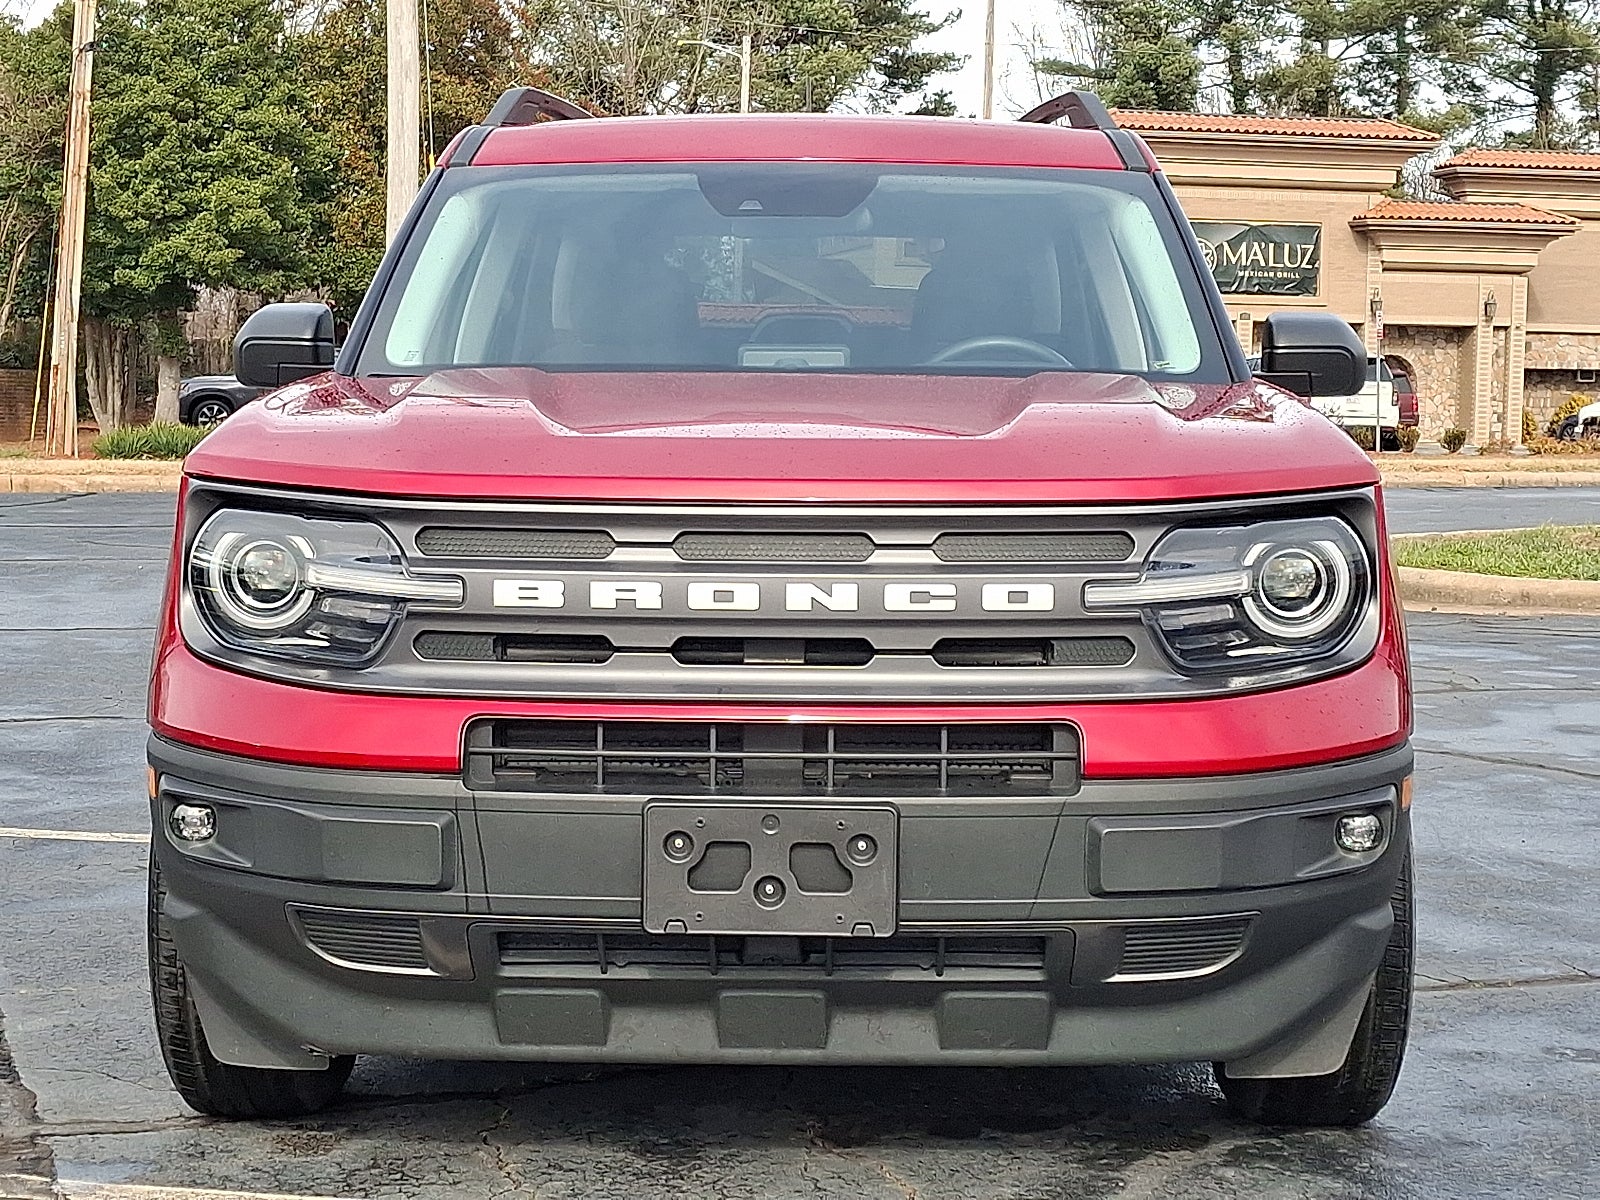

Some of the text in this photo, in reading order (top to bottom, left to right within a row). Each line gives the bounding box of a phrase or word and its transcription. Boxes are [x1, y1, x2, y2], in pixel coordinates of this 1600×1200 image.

[1238, 270, 1300, 279] MEXICAN GRILL
[492, 578, 1055, 612] BRONCO
